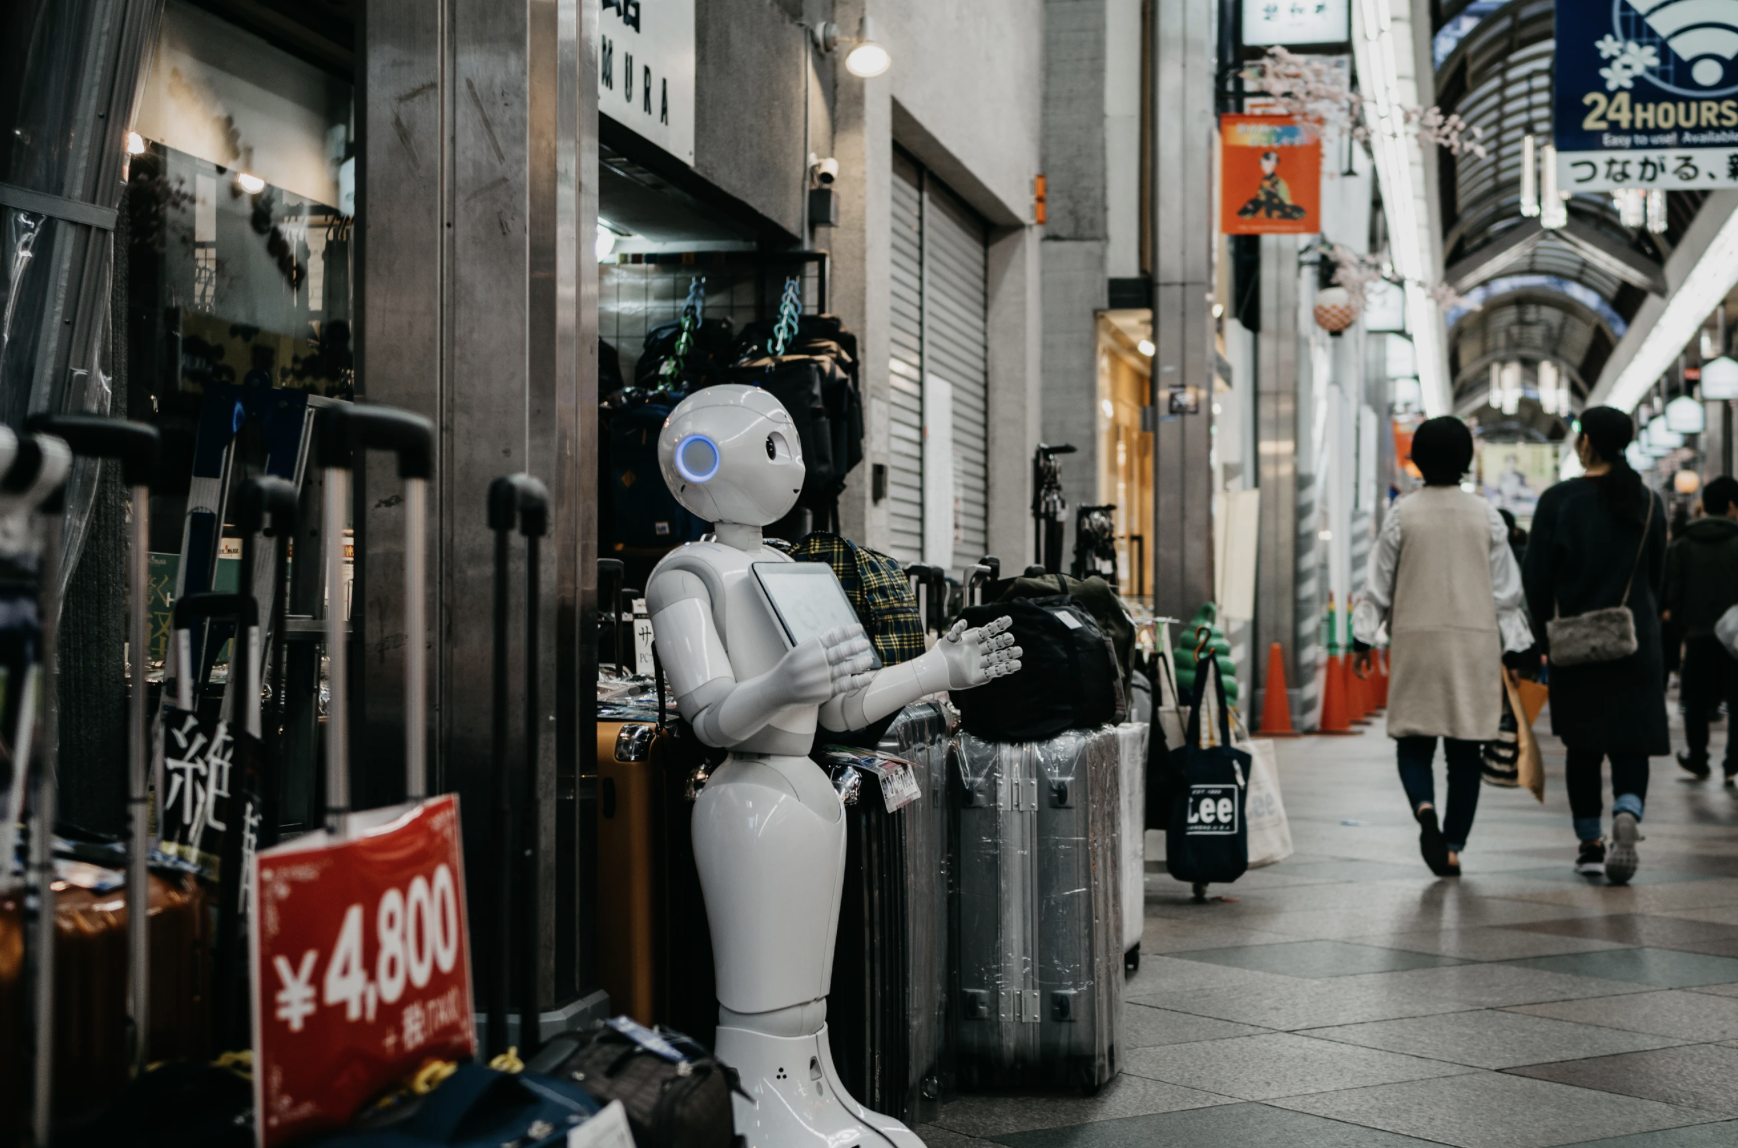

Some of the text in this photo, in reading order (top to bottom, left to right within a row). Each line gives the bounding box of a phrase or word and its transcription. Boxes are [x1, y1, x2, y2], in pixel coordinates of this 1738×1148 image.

[1602, 132, 1632, 148] Easy
[1634, 132, 1649, 146] to
[1651, 131, 1678, 146] use!
[1187, 797, 1234, 824] Lee
